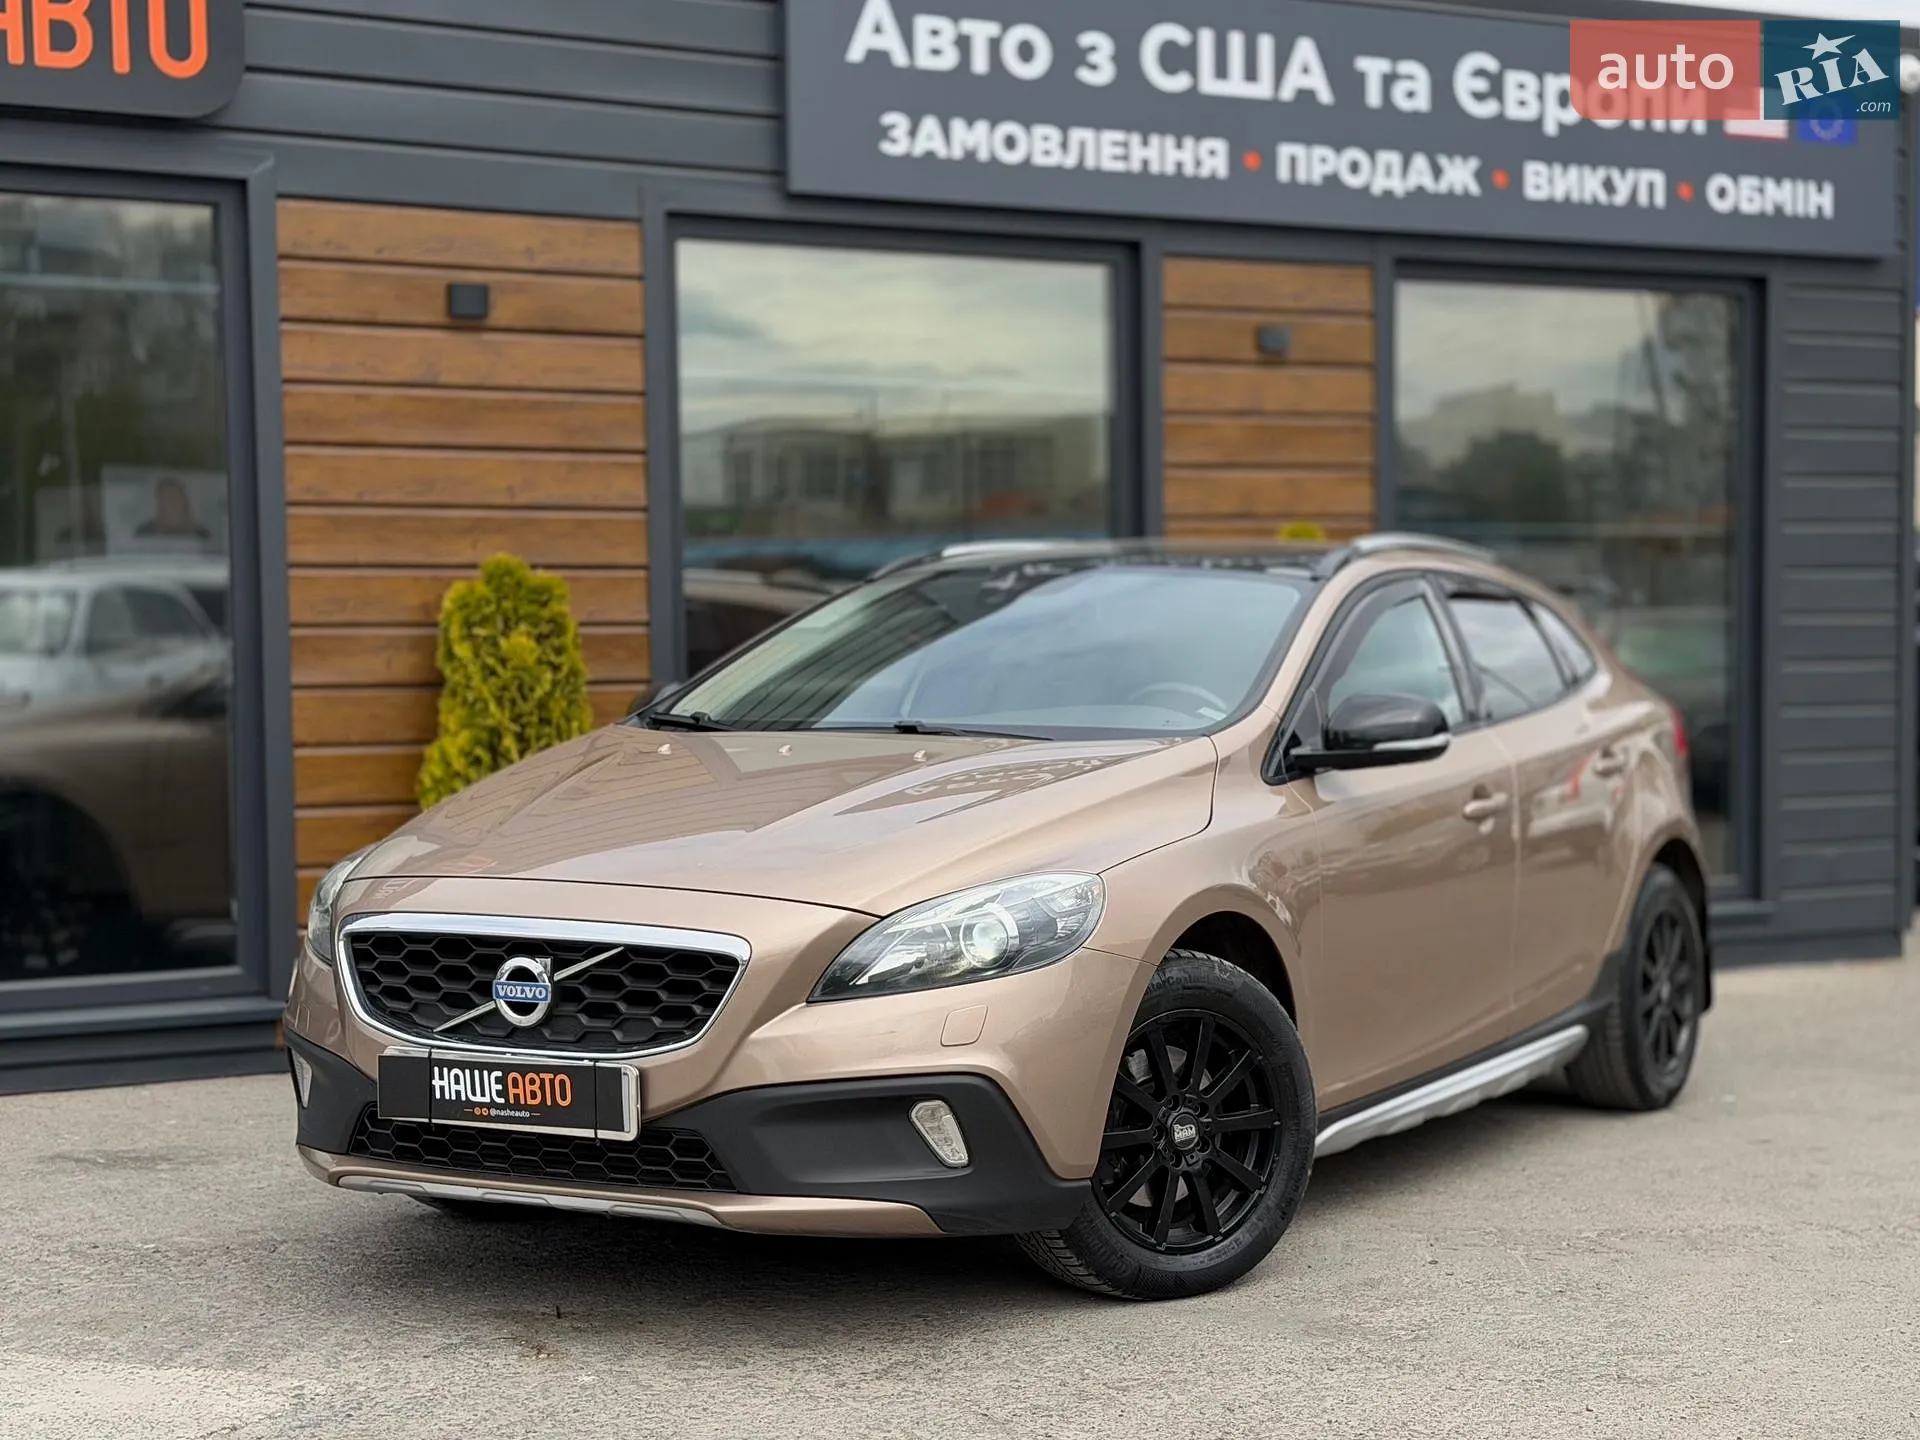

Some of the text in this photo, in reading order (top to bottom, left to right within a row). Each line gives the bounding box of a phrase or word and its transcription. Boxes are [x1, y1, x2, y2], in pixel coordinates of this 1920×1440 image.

[845, 0, 1054, 81] Авто
[1074, 30, 1118, 87] з
[1139, 21, 1335, 106] США
[1353, 54, 1433, 114] та
[878, 110, 1835, 220] ЗАМОВЛЕННЯ ПРОДАЖ ВИКУП ОБМІН
[496, 984, 547, 999] VOLVO
[431, 1066, 572, 1107] НАШЕ АВТО
[489, 1107, 530, 1118] @nasheauto
